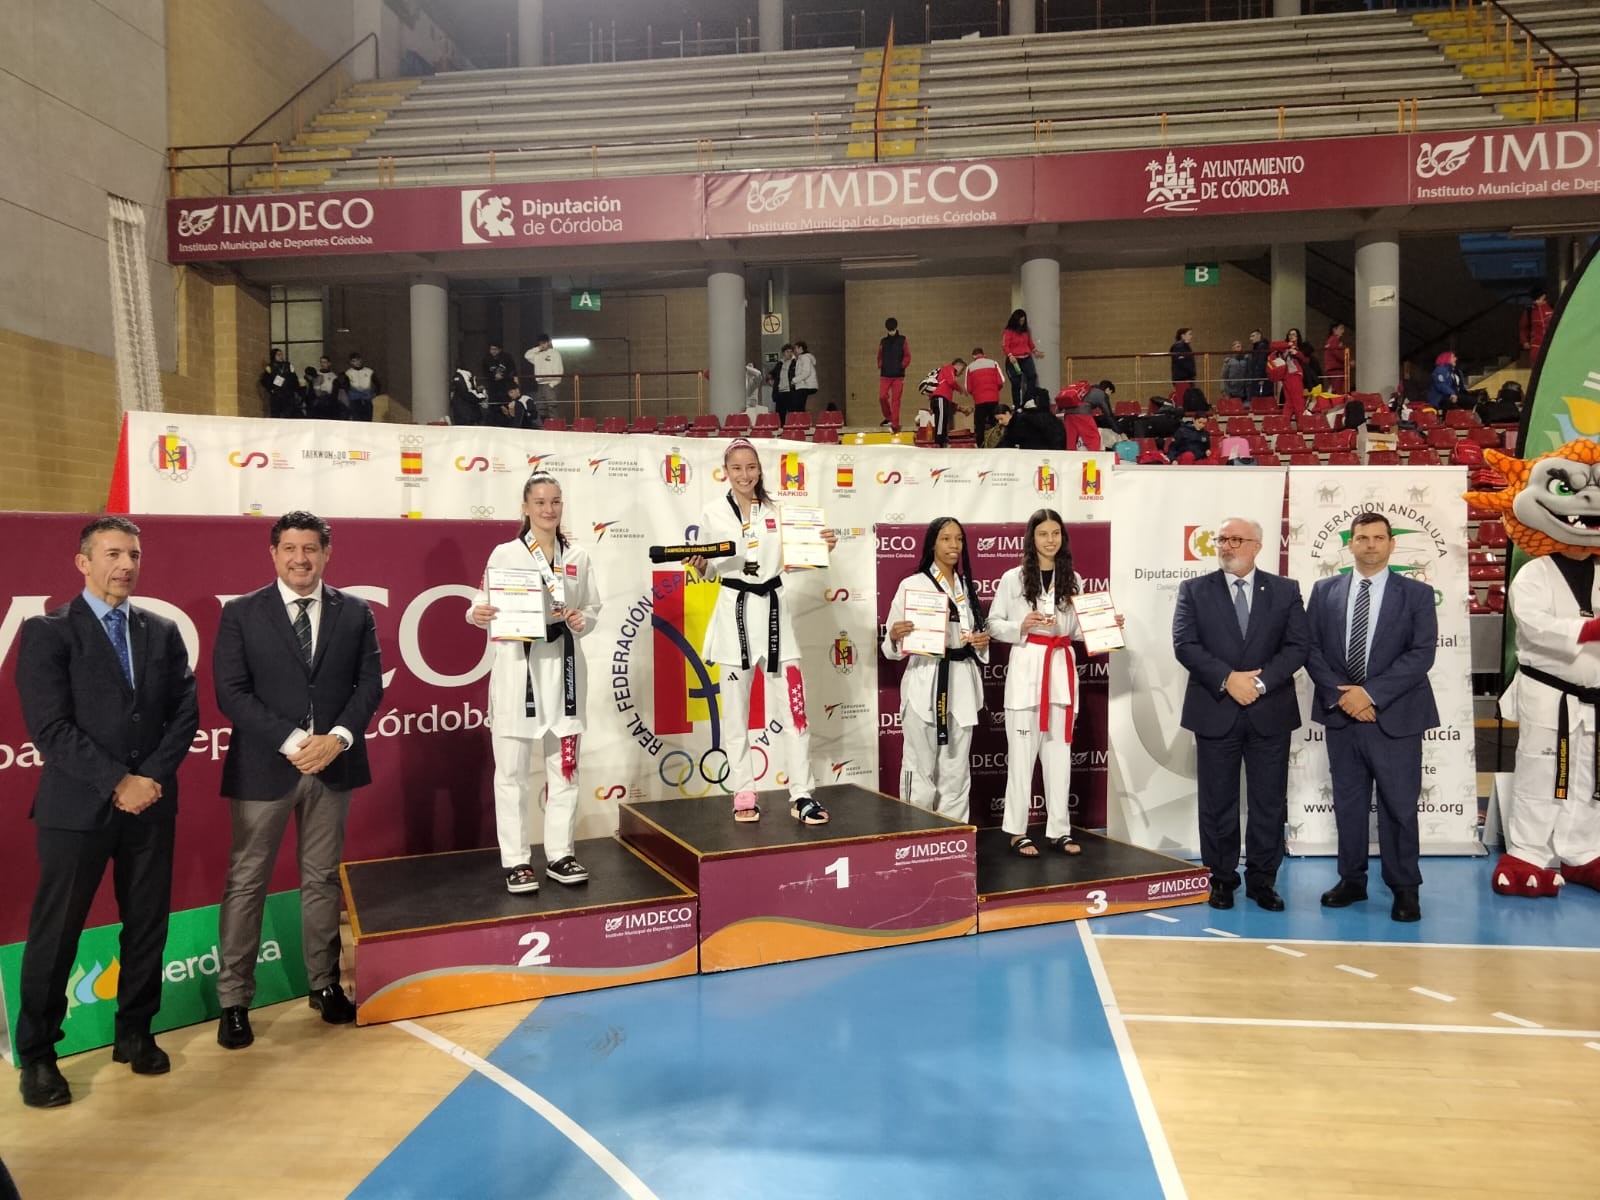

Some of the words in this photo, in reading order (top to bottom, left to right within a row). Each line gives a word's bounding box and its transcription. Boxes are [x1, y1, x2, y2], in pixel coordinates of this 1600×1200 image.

[1201, 155, 1304, 178] AYUNTAMIENTO
[804, 164, 998, 209] IMDECO
[1201, 182, 1218, 199] DE
[1221, 177, 1289, 198] CÓRDOBA
[1417, 186, 1474, 198] Instituto
[1478, 181, 1547, 195] Municipal
[1551, 180, 1569, 191] de
[223, 198, 374, 235] IMDECO
[522, 195, 621, 219] Diputación
[523, 219, 545, 236] de
[550, 216, 623, 234] Córdoba
[748, 220, 797, 233] Instituto
[800, 216, 861, 231] Municipal
[864, 214, 880, 226] de
[883, 212, 940, 228] Deportes
[943, 209, 997, 223] Córdoba
[179, 243, 218, 252] Instituto
[220, 239, 267, 252] Municipal
[269, 238, 282, 248] de
[284, 237, 329, 249] Deportes
[330, 234, 373, 246] Córdoba
[1195, 266, 1209, 282] B
[579, 291, 592, 306] A
[1311, 502, 1385, 559] FEDERACION
[1388, 503, 1448, 559] ANDALUZA
[1134, 568, 1197, 581] Diputación
[612, 595, 654, 712] FEDERACIÓN
[626, 712, 663, 757] REAL
[912, 840, 967, 858] IMDECO
[825, 856, 849, 889] 1
[1162, 876, 1209, 893] IMDECO
[1086, 890, 1108, 914] 3
[625, 907, 692, 929] IMDECO
[518, 931, 551, 968] 2
